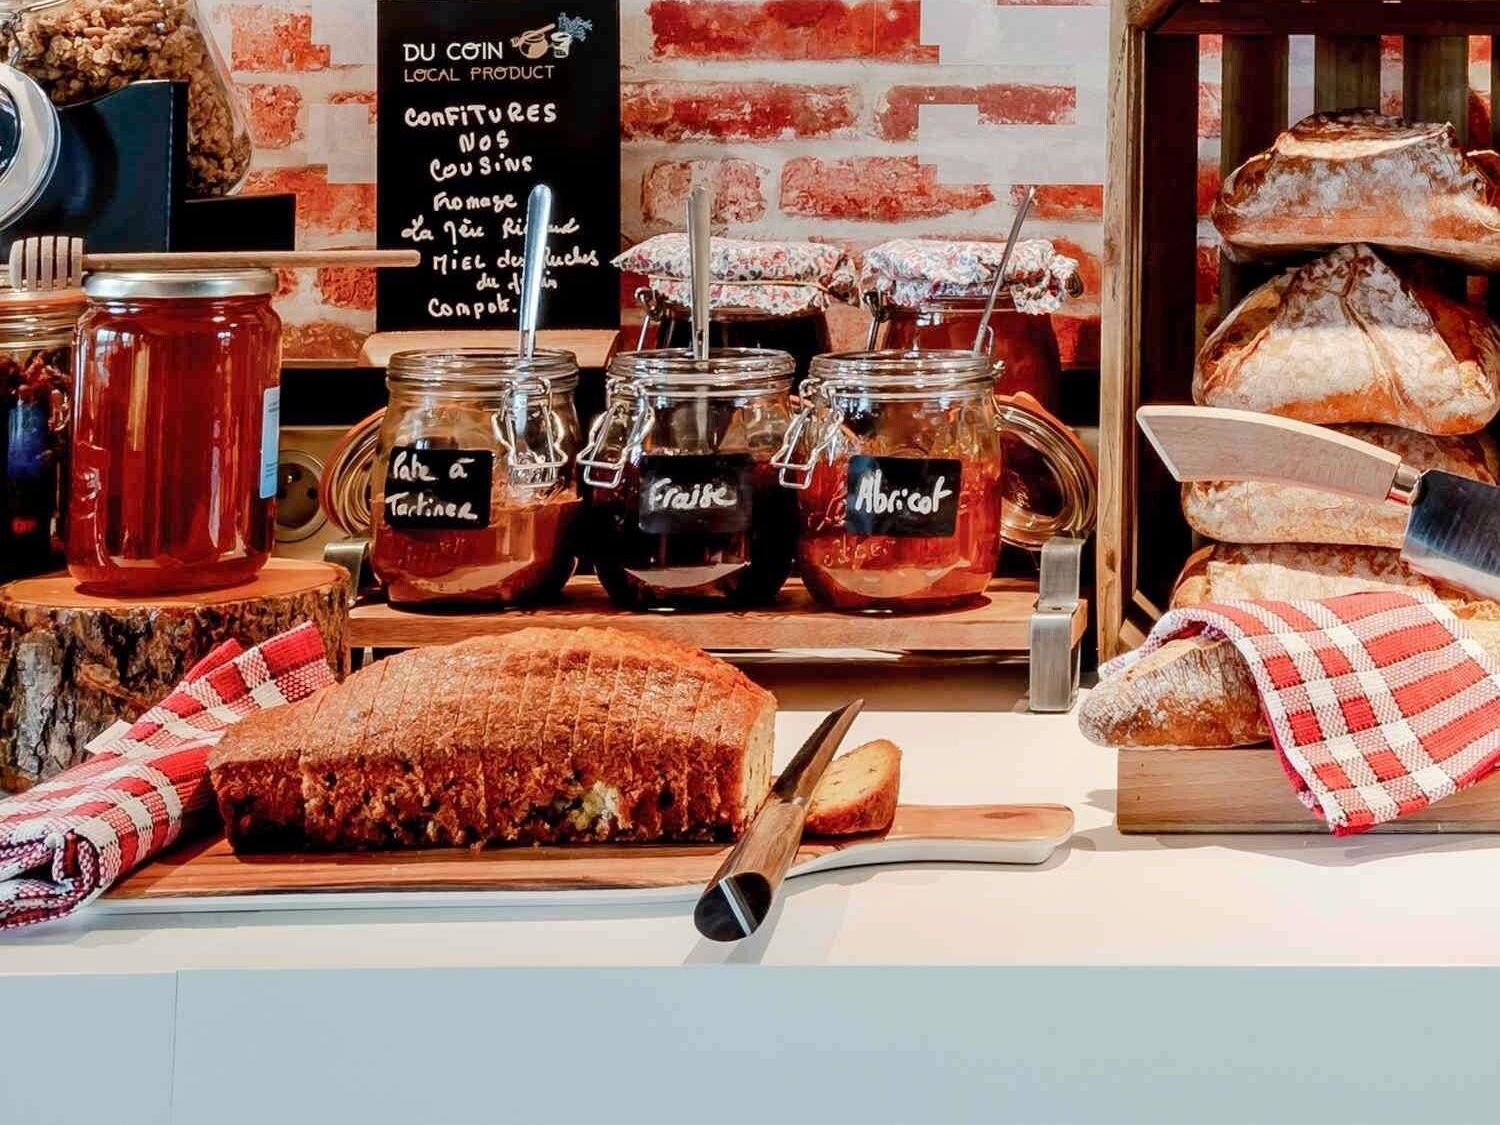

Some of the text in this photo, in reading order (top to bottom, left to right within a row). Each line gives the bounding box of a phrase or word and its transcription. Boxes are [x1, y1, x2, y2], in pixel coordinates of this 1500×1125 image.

[402, 41, 503, 62] DU COIN
[404, 65, 555, 82] LOCAL PRODUCT
[648, 477, 738, 512] Fraise
[855, 468, 953, 515] Abricot
